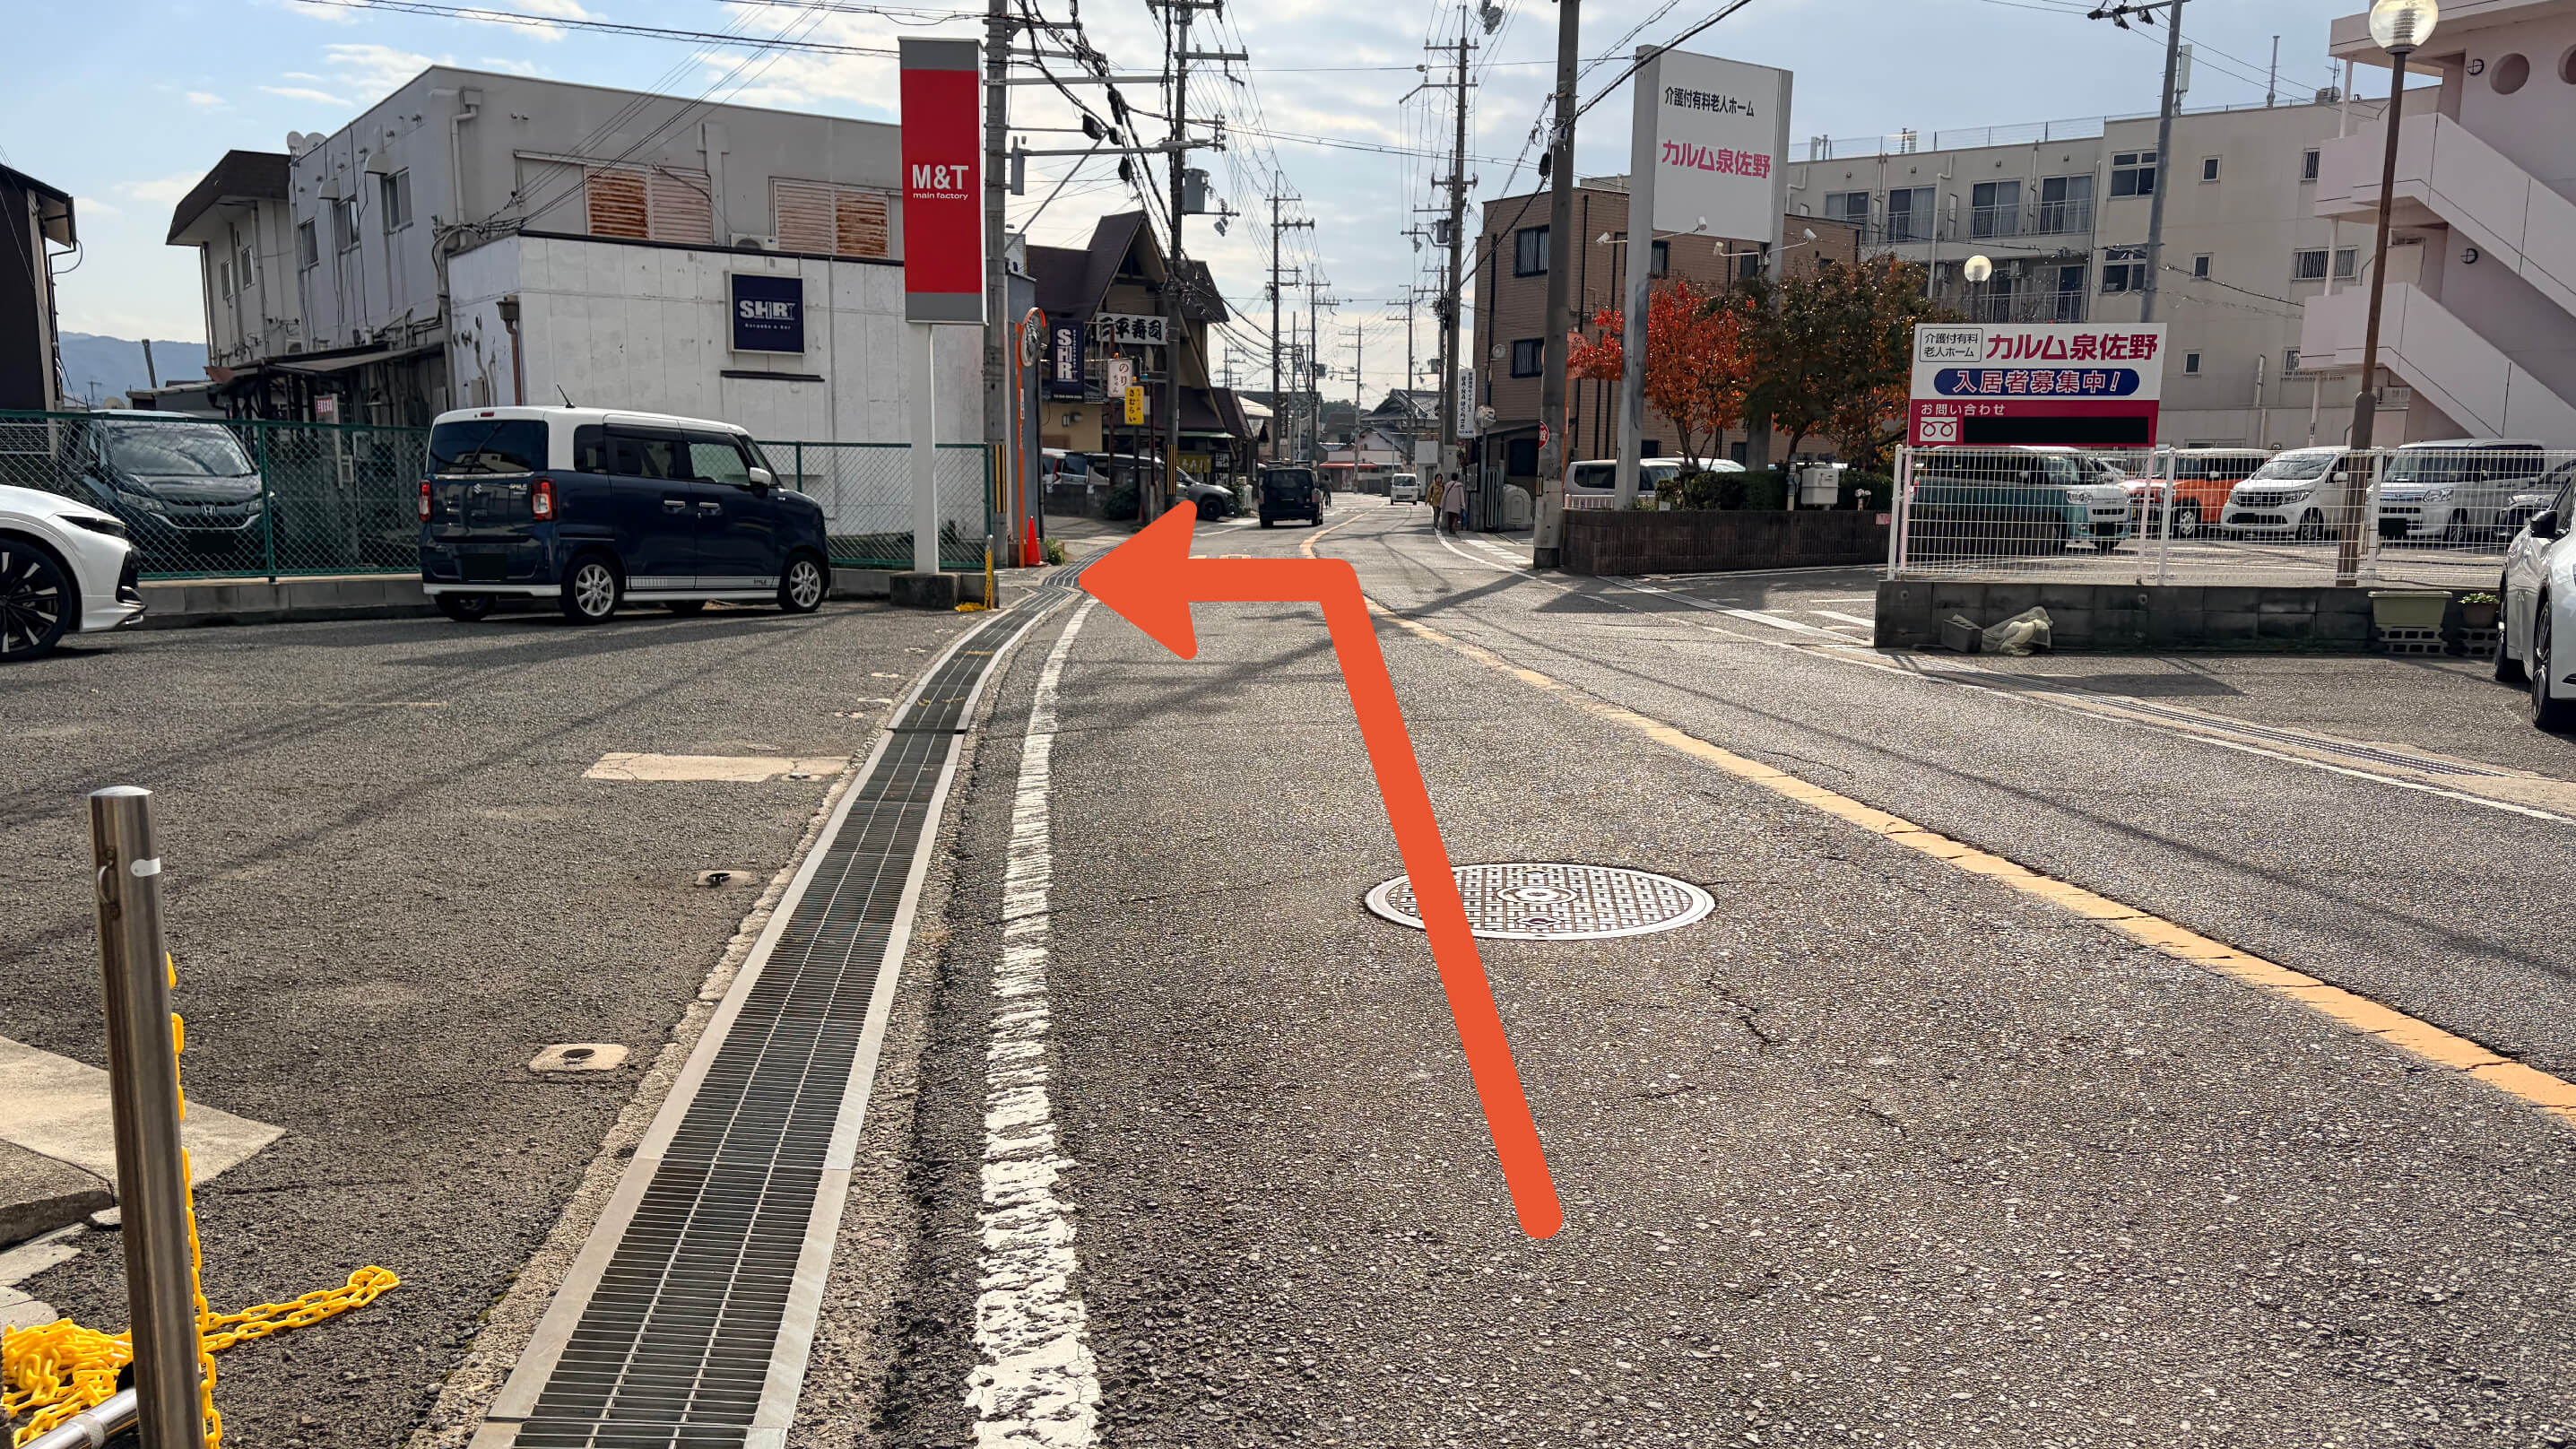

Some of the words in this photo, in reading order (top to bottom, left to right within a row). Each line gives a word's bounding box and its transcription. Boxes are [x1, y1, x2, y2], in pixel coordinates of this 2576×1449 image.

[1664, 86, 1755, 117] 介護付有料老人ホーム
[1661, 139, 1772, 179] カルム泉佐野
[912, 164, 969, 190] M&T
[936, 192, 968, 201] factory
[1099, 316, 1163, 342] 三平寿司
[1924, 333, 1979, 344] 介護付有料
[1923, 347, 1975, 358] 老人ホーム
[1985, 333, 2159, 361] カルム泉佐野
[1118, 363, 1130, 386] のり
[1921, 403, 2007, 416] お問い合わせ
